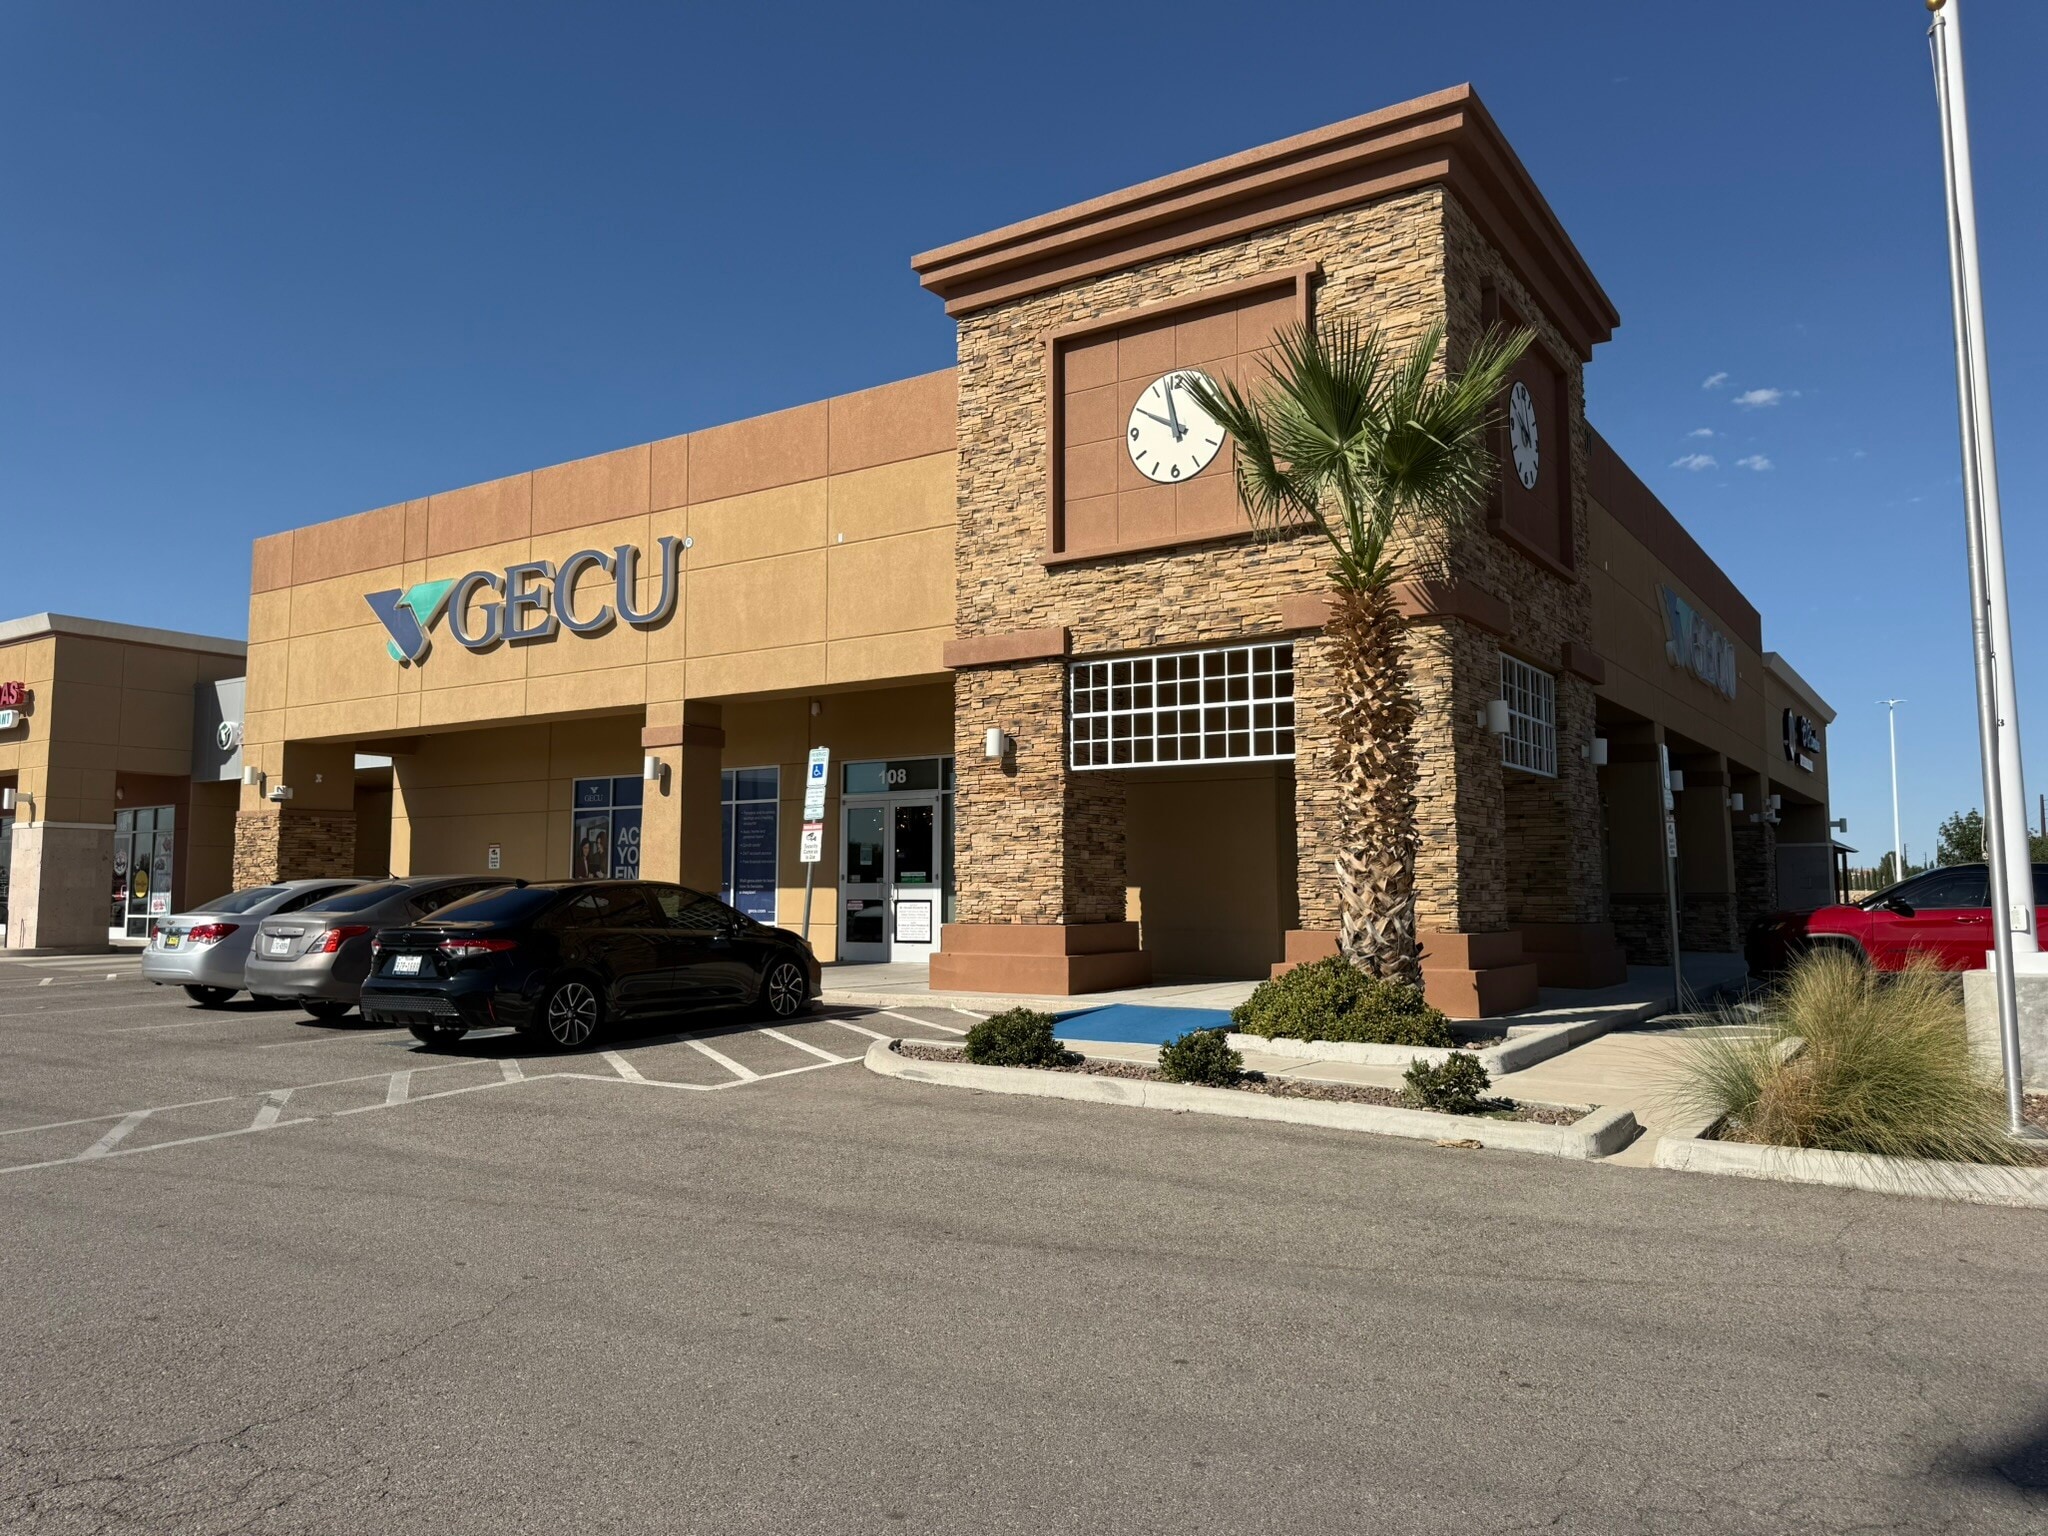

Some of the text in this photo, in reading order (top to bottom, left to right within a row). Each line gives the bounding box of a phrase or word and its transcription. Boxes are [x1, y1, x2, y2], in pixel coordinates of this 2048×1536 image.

[1130, 427, 1140, 442] 9
[1170, 464, 1181, 479] 6
[448, 536, 684, 648] GECU
[878, 768, 907, 785] 108
[584, 794, 603, 802] GECU
